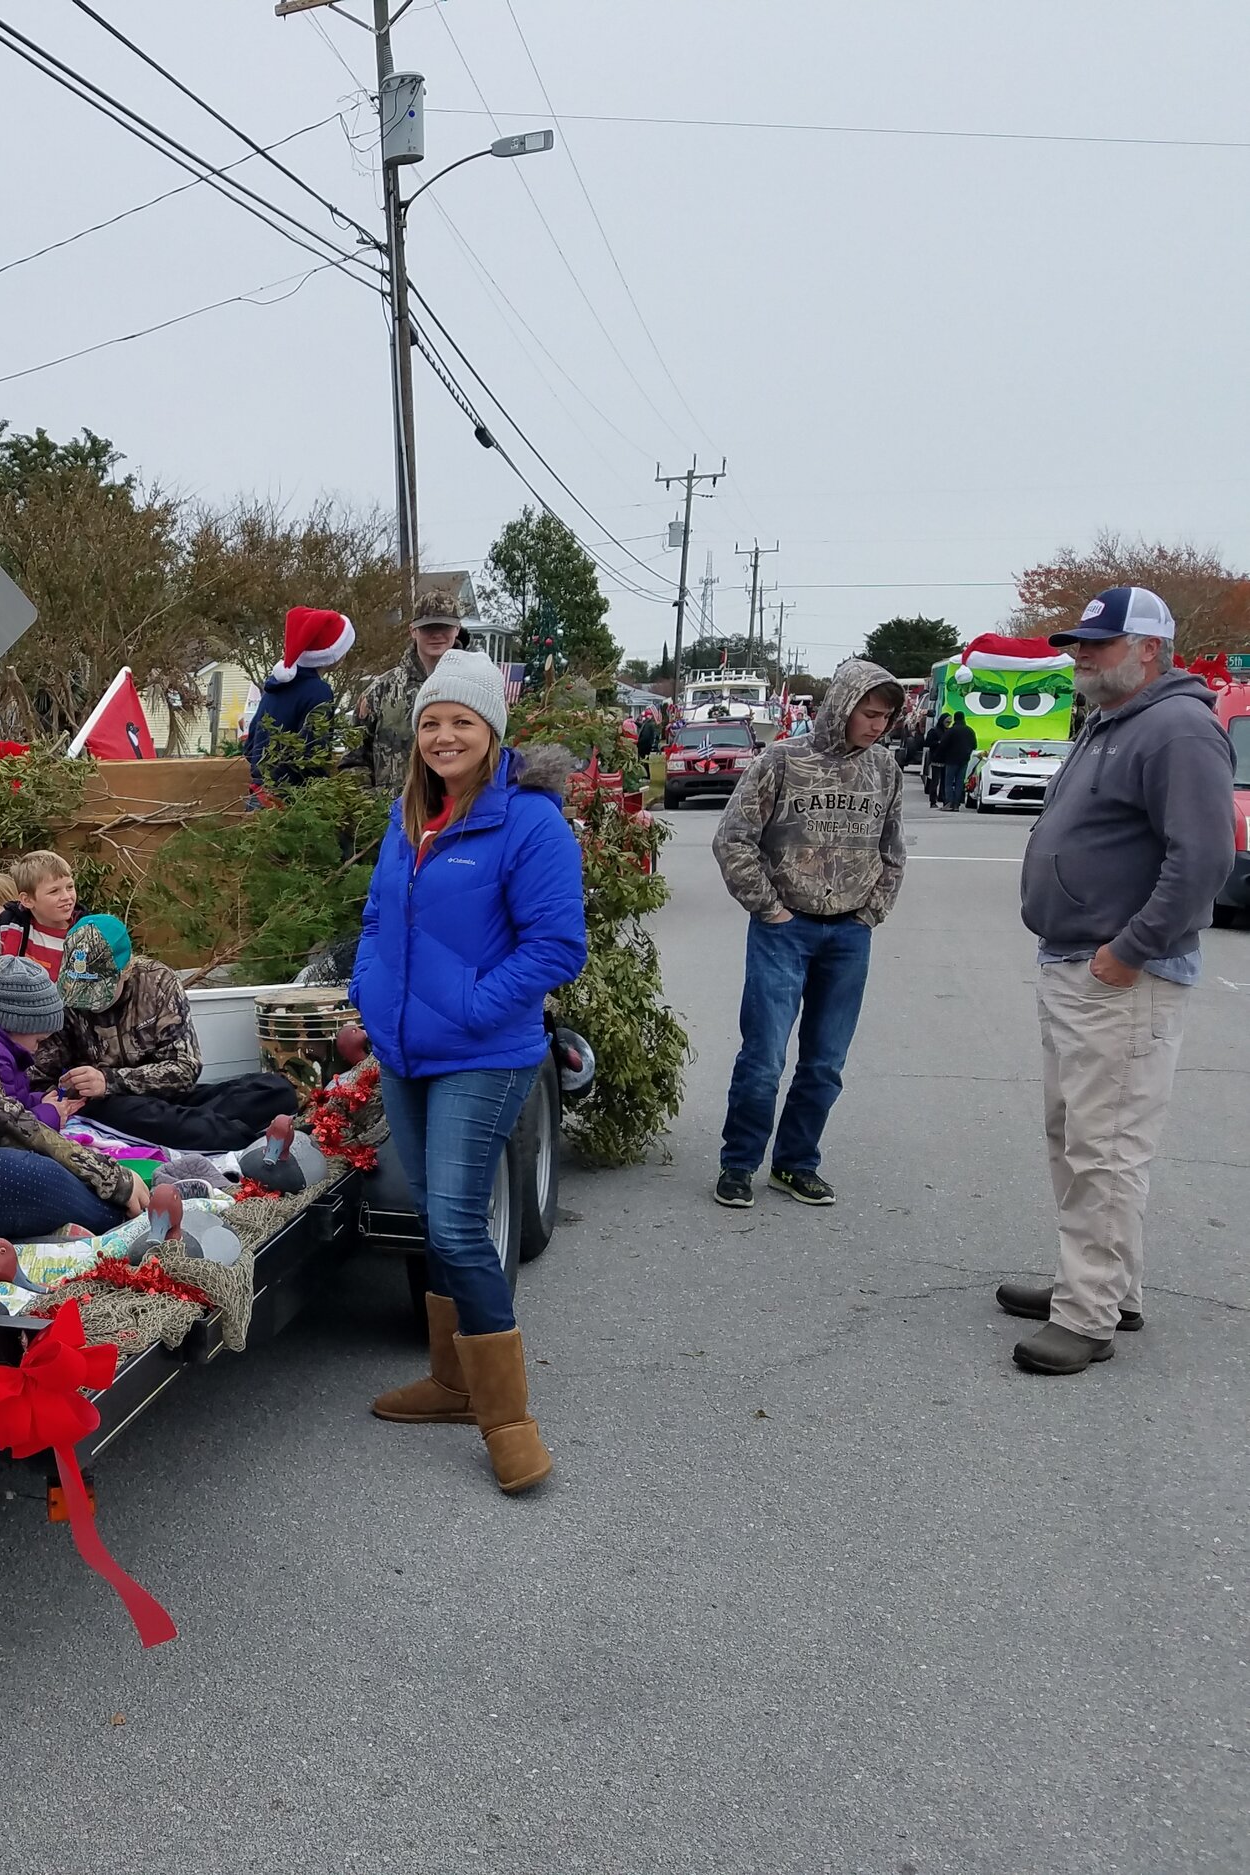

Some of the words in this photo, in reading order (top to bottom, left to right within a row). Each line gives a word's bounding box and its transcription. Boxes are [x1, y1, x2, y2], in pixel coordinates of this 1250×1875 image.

[1229, 656, 1243, 667] 5th
[793, 793, 882, 819] CABELA'S
[806, 820, 839, 833] SINCE
[847, 822, 869, 835] 1961
